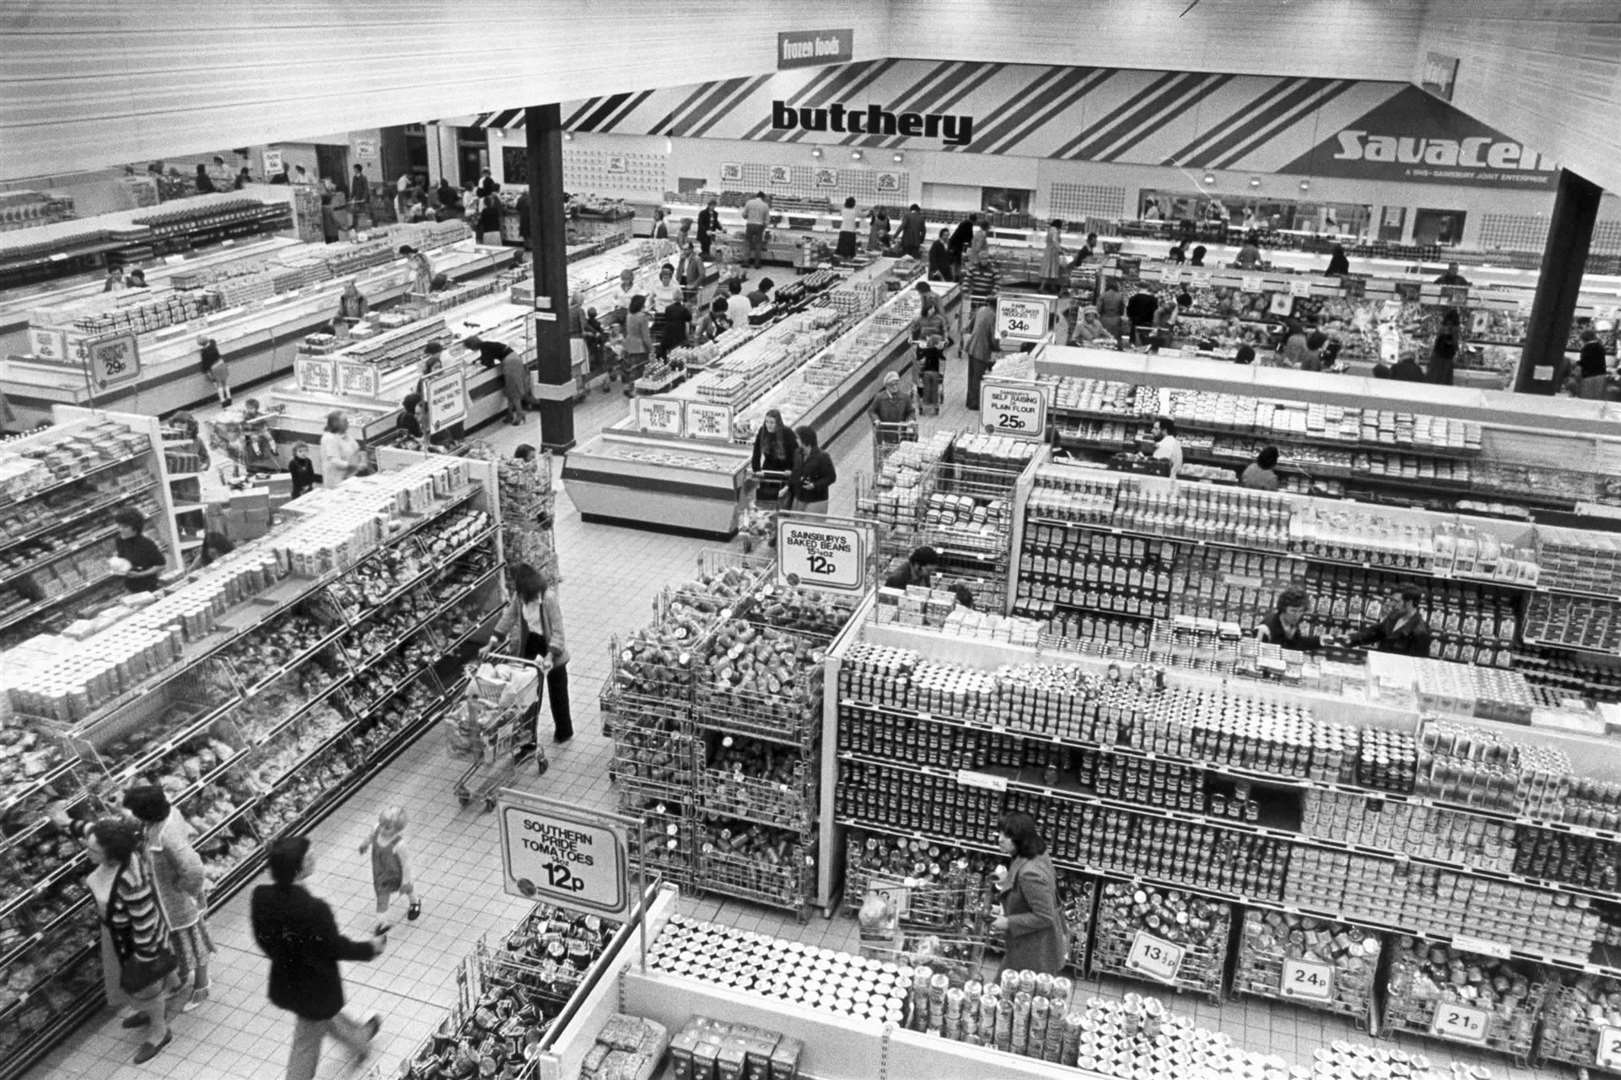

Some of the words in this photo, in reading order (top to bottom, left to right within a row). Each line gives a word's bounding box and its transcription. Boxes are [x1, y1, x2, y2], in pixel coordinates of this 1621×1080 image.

[783, 39, 813, 60] frozen
[815, 36, 840, 56] foods
[772, 100, 973, 145] butchery
[1334, 130, 1561, 171] SavaCen
[1008, 319, 1030, 331] 34p
[1012, 405, 1035, 413] FLOUR
[999, 413, 1026, 429] 25p
[786, 536, 818, 549] BAKED
[820, 540, 851, 553] BEANS
[806, 556, 836, 575] 12p
[523, 819, 592, 846] SOUTHERN
[521, 838, 594, 866] TOMATOES
[541, 834, 578, 852] PRIDE
[542, 862, 585, 893] 12p
[1295, 969, 1327, 988] 24p
[1447, 1012, 1479, 1030] 21p
